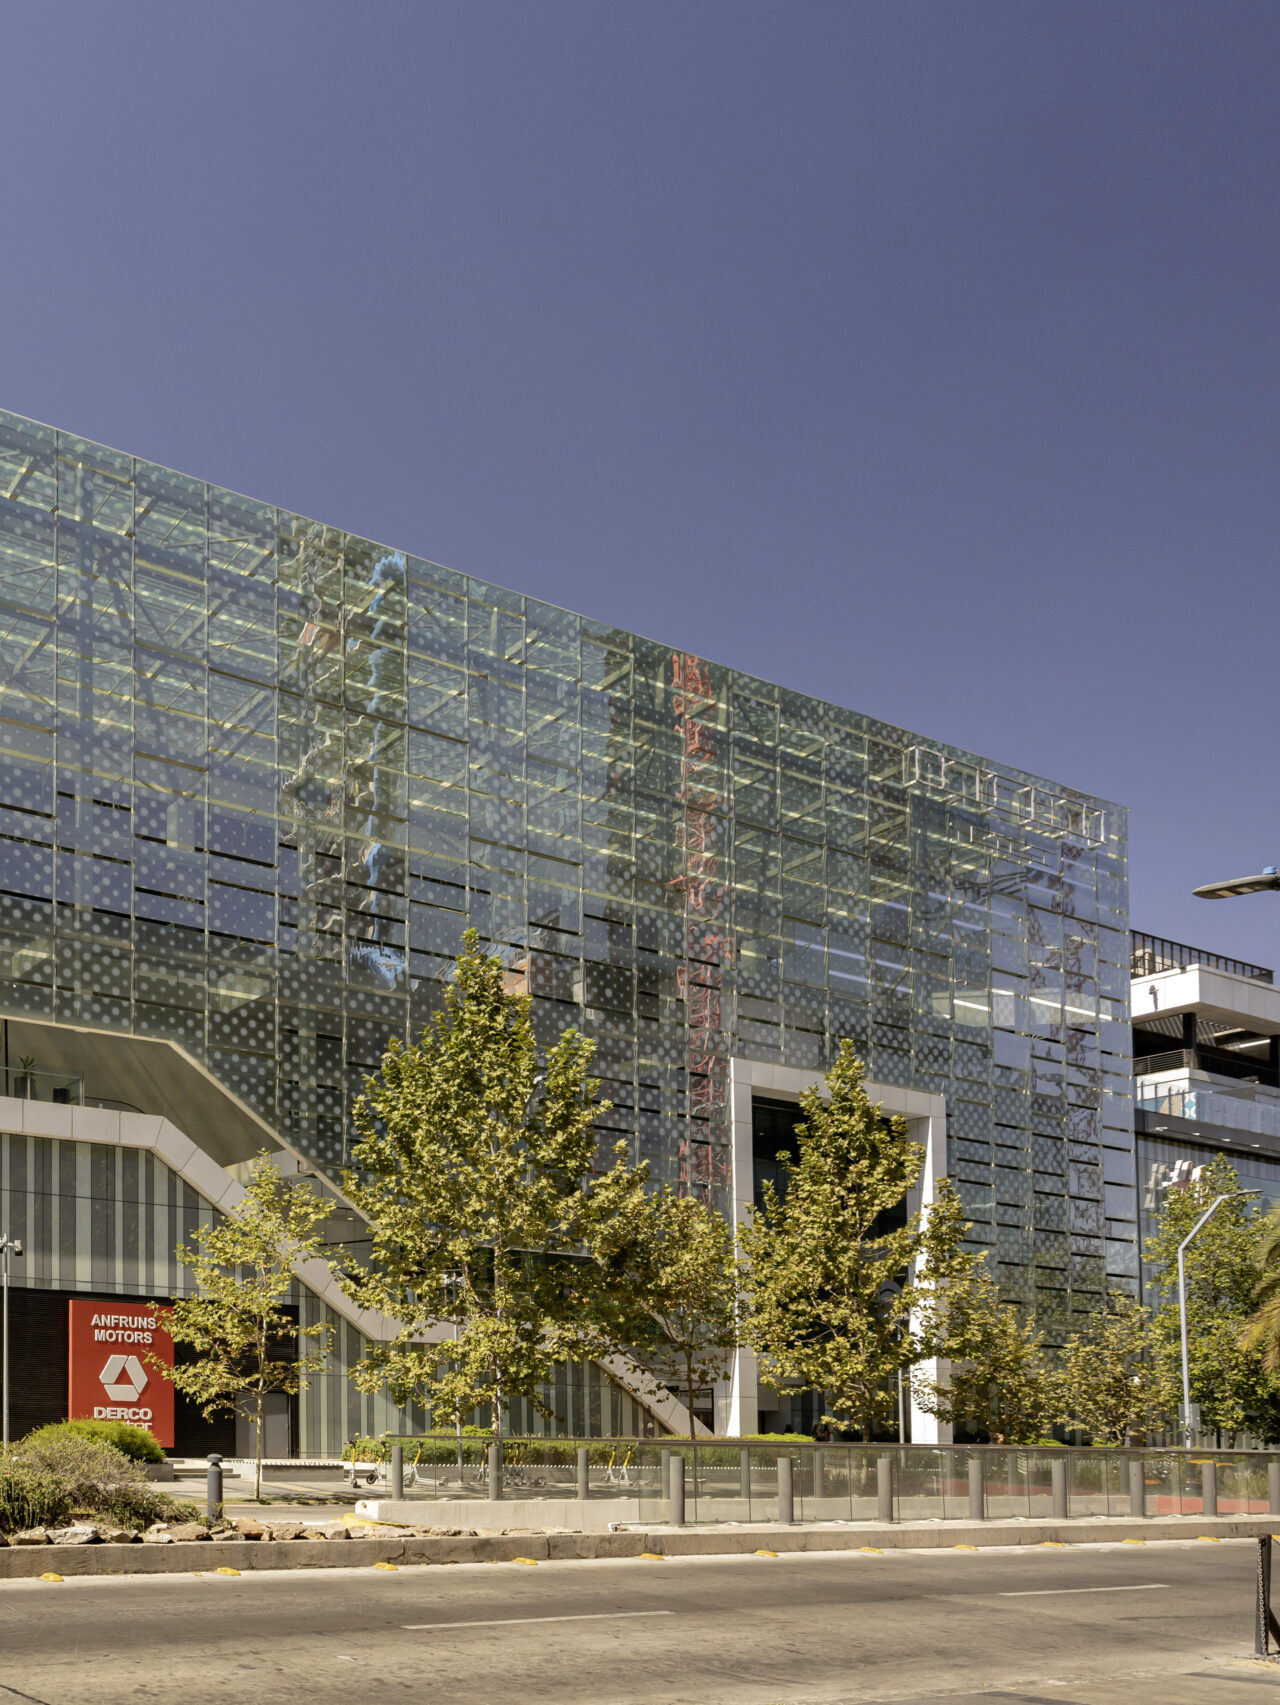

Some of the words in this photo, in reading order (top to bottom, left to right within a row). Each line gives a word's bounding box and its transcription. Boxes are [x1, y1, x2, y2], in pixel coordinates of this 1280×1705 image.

[91, 1314, 157, 1329] ANFRUNS
[94, 1329, 153, 1344] MOTORS
[93, 1406, 153, 1420] DERCO
